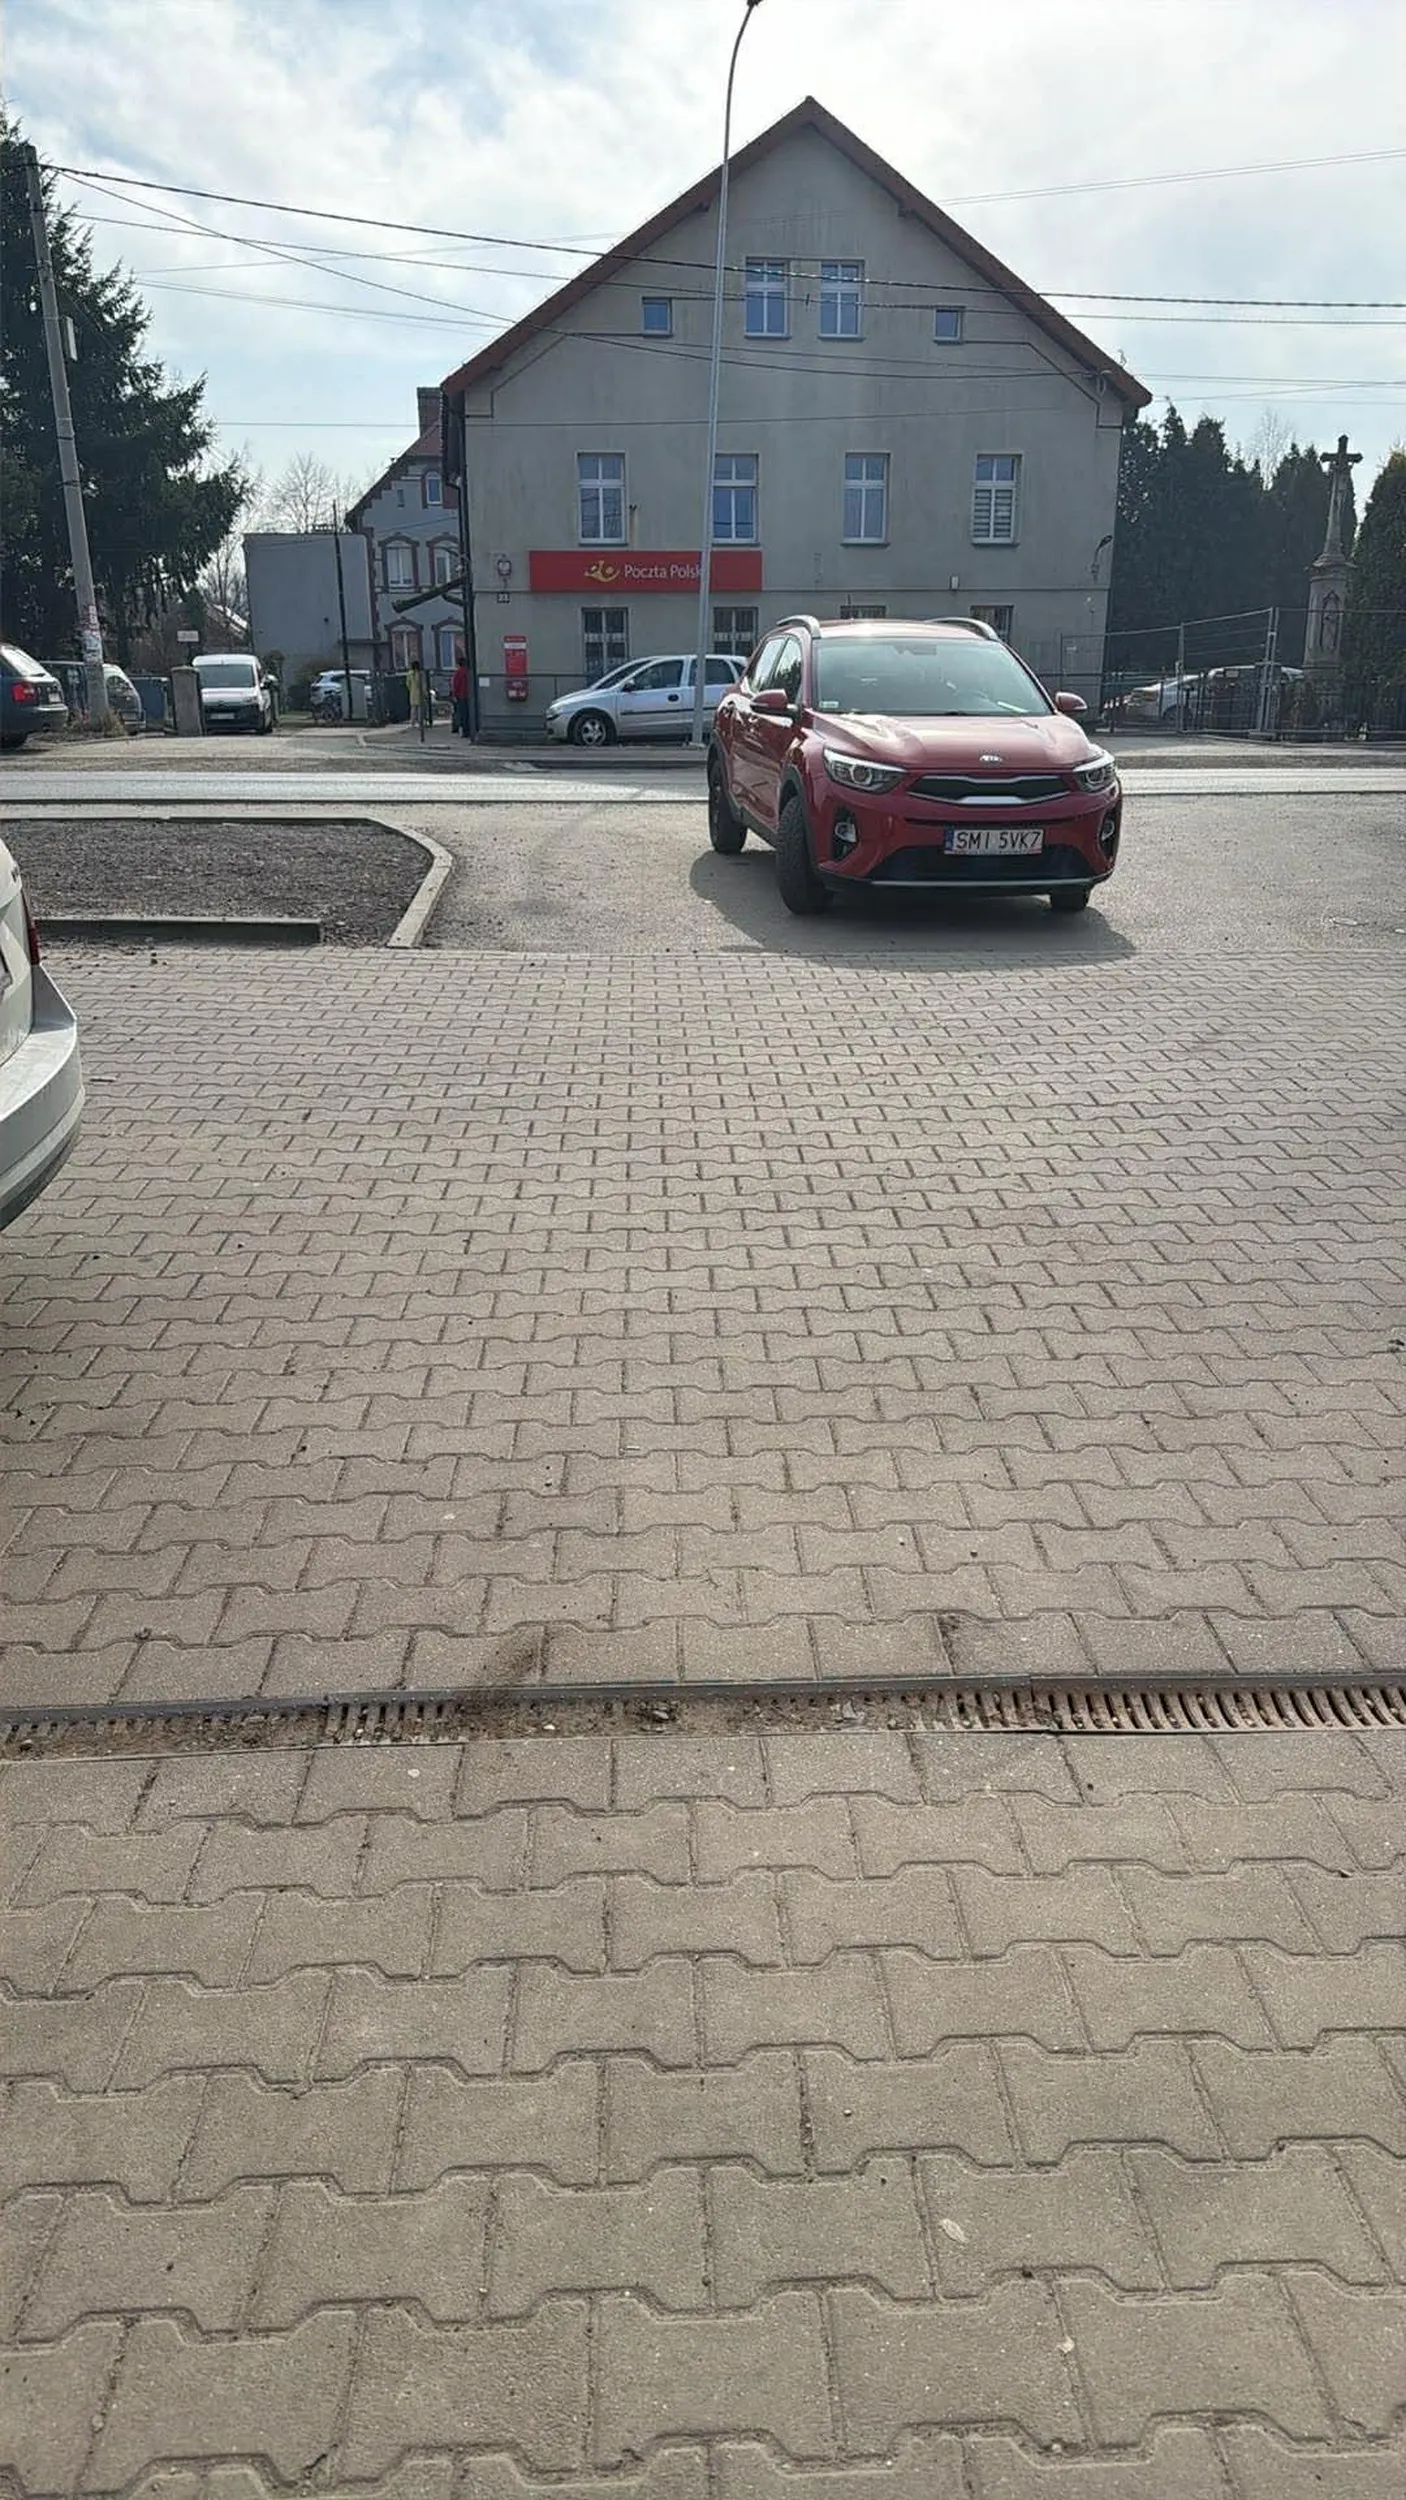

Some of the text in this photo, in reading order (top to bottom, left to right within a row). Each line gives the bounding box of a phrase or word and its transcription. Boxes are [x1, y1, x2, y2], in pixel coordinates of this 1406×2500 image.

[624, 564, 703, 579] Poczta Polsk
[956, 831, 990, 849] SMI
[998, 831, 1041, 849] 5VK7
